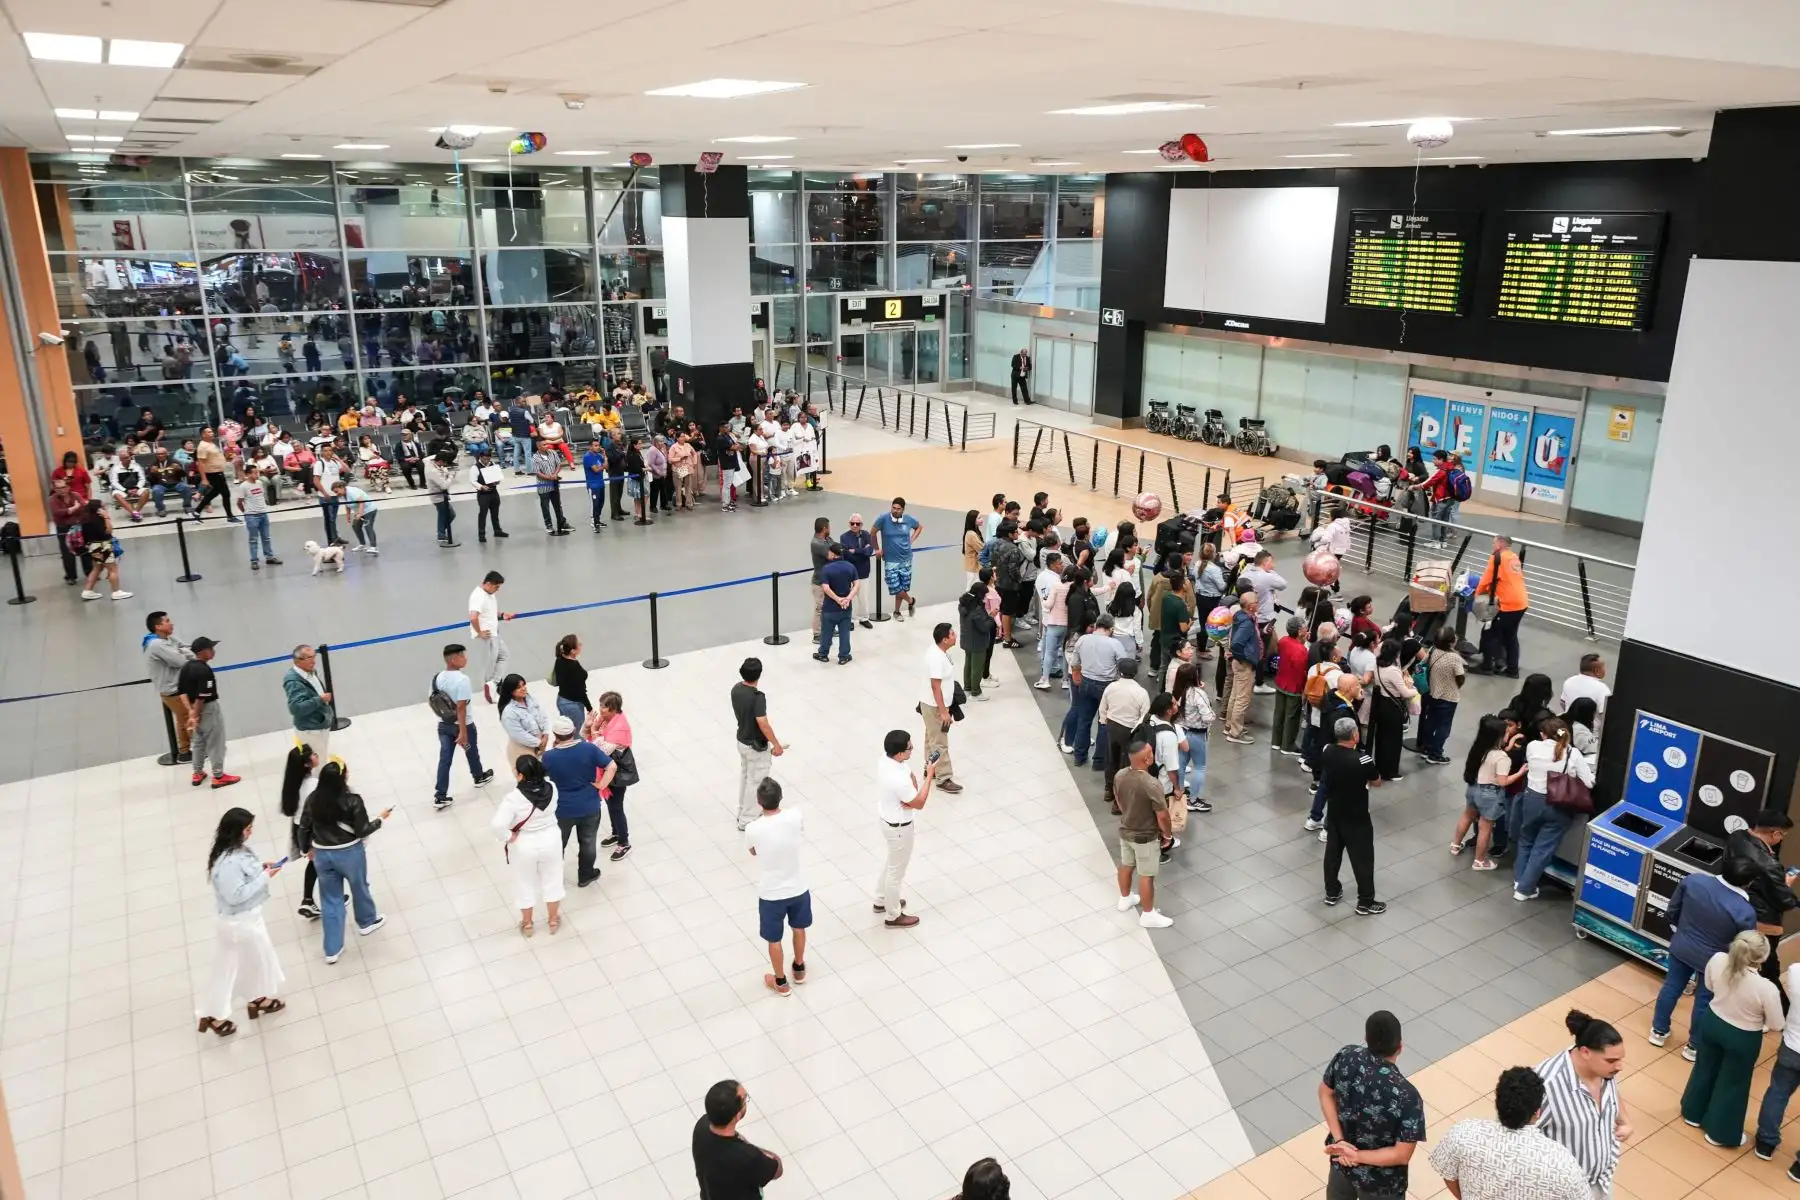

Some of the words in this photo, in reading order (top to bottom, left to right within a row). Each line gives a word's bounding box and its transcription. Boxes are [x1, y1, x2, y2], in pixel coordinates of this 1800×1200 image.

[1572, 216, 1602, 225] Llegadas
[923, 295, 938, 304] SALIDA
[657, 308, 667, 316] EXI
[890, 302, 897, 316] 2
[1650, 721, 1667, 730] LIMA
[1648, 727, 1677, 739] AIRPORT
[1592, 837, 1603, 845] DALE
[1610, 844, 1630, 856] RESPIRO
[1597, 845, 1616, 856] PLANETA
[1654, 864, 1667, 872] GIVE
